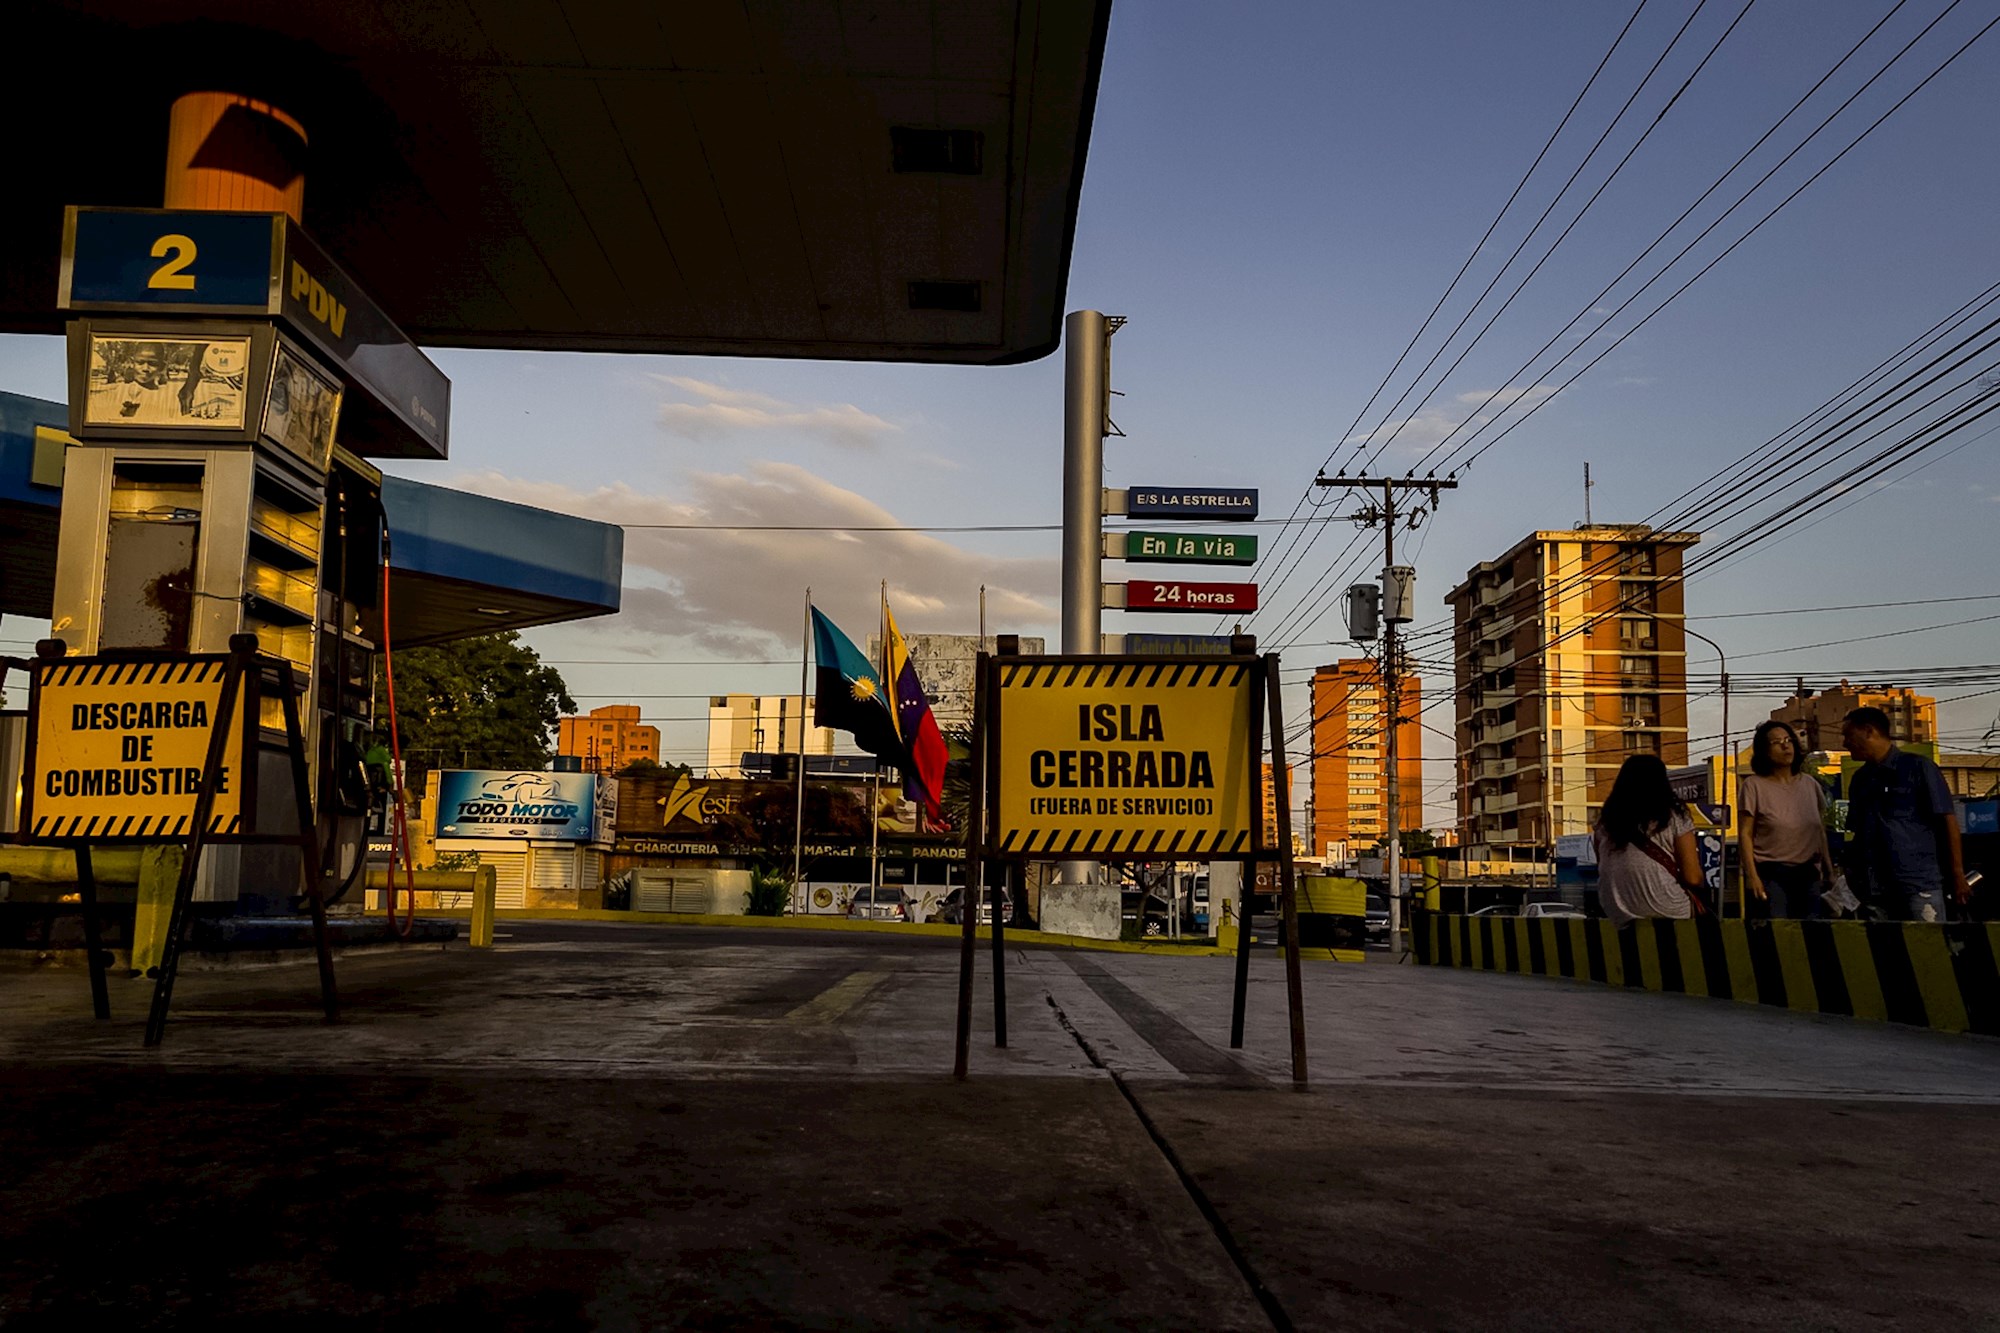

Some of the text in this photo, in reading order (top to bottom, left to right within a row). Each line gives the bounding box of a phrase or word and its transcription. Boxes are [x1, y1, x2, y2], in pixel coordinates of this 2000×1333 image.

[148, 234, 197, 289] 2
[292, 260, 347, 338] PDV
[1137, 494, 1252, 507] E/S LA ESTRELLA
[1142, 536, 1235, 557] En la via
[1153, 585, 1235, 604] 24 horas
[72, 701, 208, 731] DESCARGA
[1079, 704, 1164, 742] ISLA
[121, 735, 153, 762] DE
[1030, 750, 1215, 788] CERRADA
[46, 767, 229, 798] COMBUSTIBE
[458, 803, 579, 818] TODO MOTOR
[1030, 797, 1213, 816] (FUERA DE SERVICIO)
[478, 816, 543, 825] REPUESTOS
[368, 843, 399, 852] PDVS
[633, 843, 719, 855] CHARCUTERIA
[912, 847, 967, 859] PANADE
